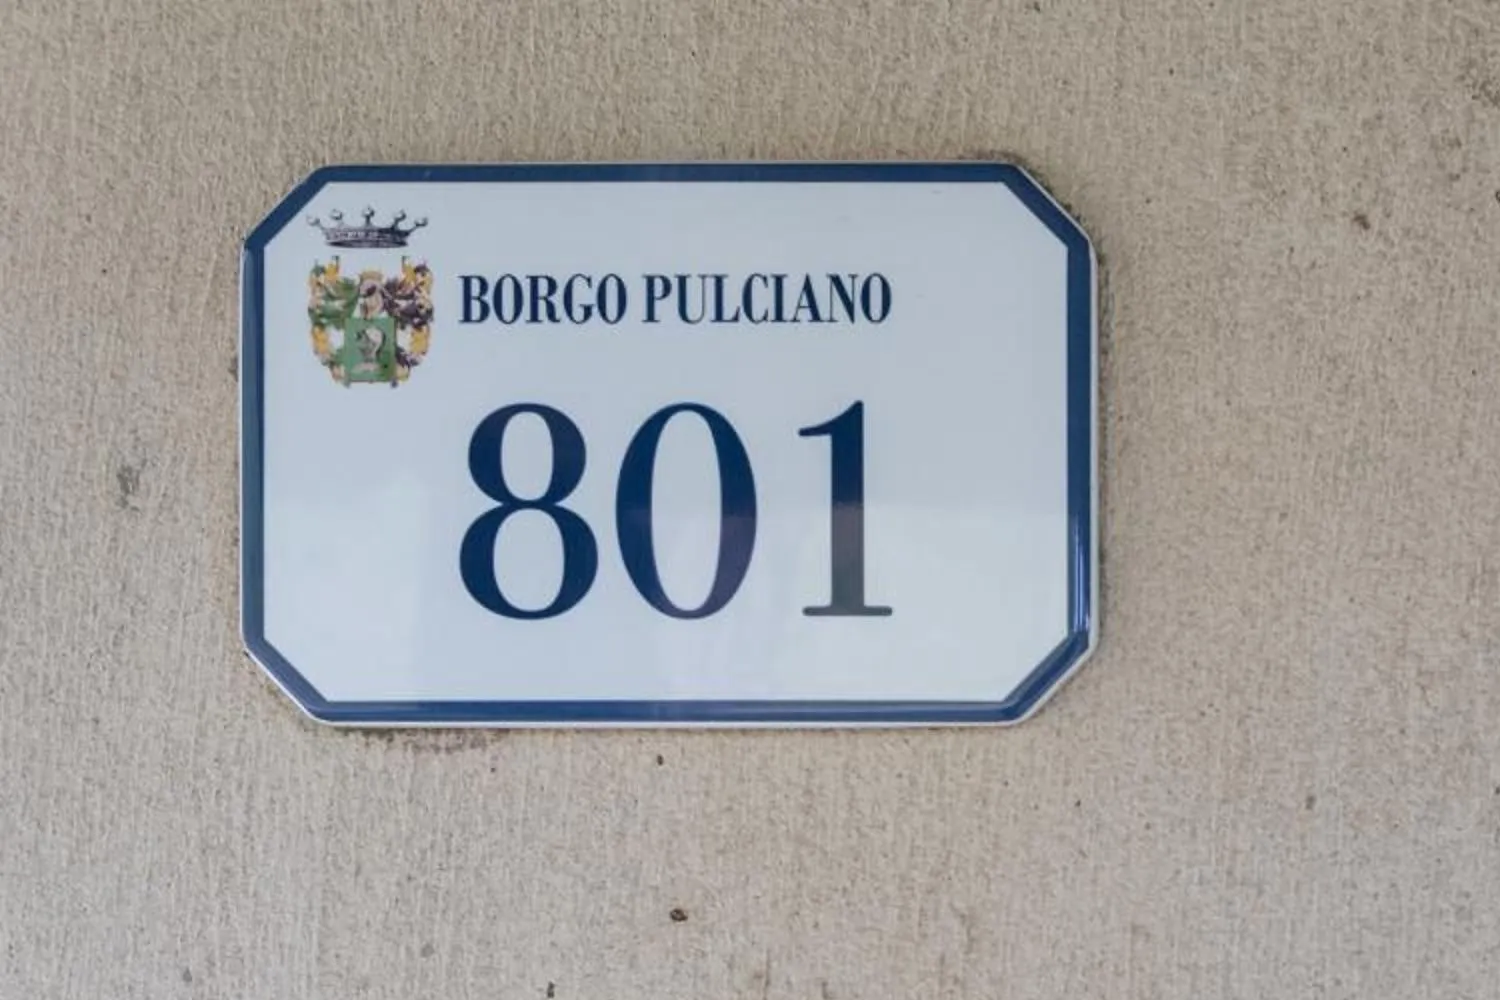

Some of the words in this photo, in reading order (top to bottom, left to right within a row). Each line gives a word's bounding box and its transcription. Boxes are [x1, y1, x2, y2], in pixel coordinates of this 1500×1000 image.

[458, 273, 628, 325] BORGO
[642, 273, 892, 325] PULCIANO
[458, 399, 893, 621] 801
